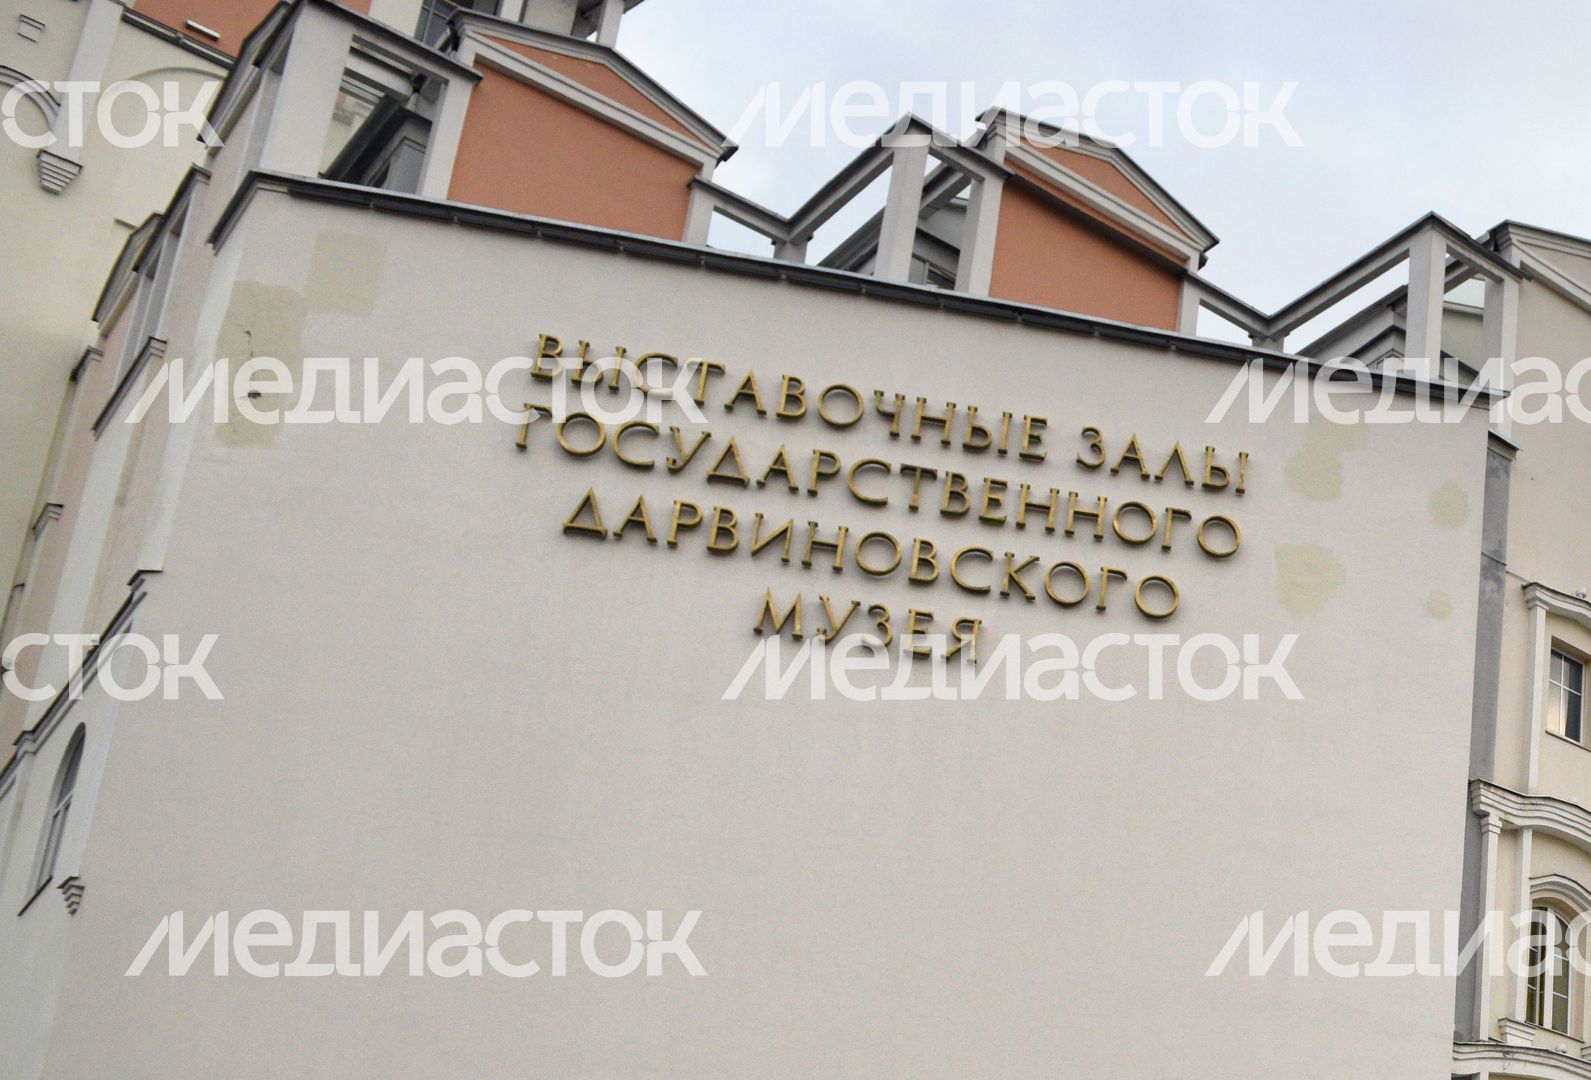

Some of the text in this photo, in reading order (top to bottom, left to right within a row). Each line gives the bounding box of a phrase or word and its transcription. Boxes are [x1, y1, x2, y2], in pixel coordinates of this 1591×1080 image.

[515, 402, 1242, 559] ГОСУДАРСТВЕННОГО
[530, 333, 1250, 495] ВЫСТАВОЧНЫЕ ЗАЛЫ
[561, 486, 1180, 619] ДАРВИНОВСКОГО
[753, 587, 984, 665] МУЗЕЯ
